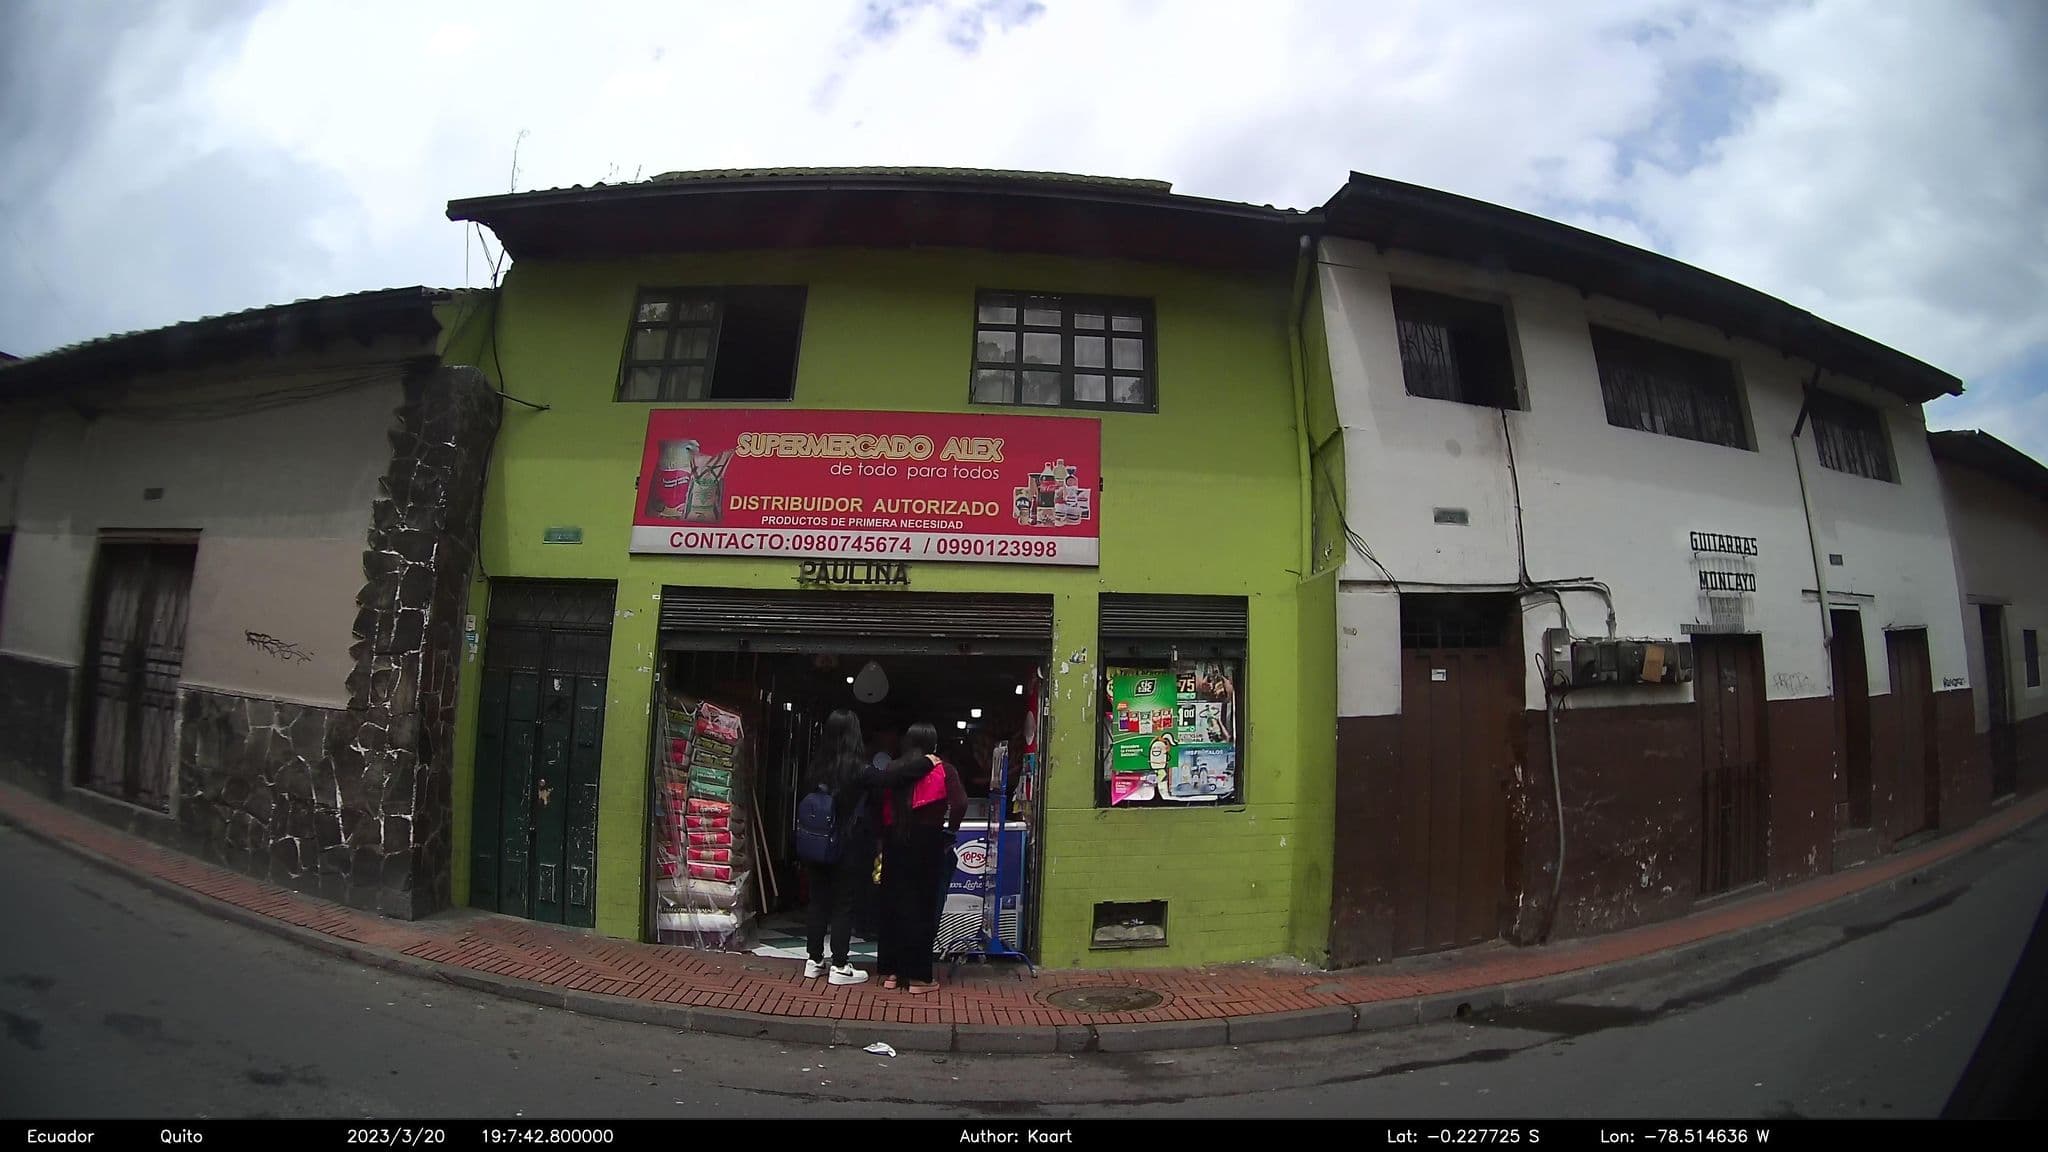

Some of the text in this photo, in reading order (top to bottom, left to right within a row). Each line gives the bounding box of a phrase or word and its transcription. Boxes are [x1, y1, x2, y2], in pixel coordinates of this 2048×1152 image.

[736, 432, 1005, 462] SUPERMERCADO ALEX
[830, 461, 1000, 480] de todo para todos
[729, 495, 1000, 516] DISTRIBUIDOR AUTORIZADO
[761, 516, 964, 530] PRODUCTOS DE PRIMERA NECESIDAD
[936, 538, 1057, 558] 0990123998
[1690, 531, 1758, 556] GUITARRAS
[800, 560, 912, 586] PAULINA
[1699, 570, 1757, 592] MONCAYO
